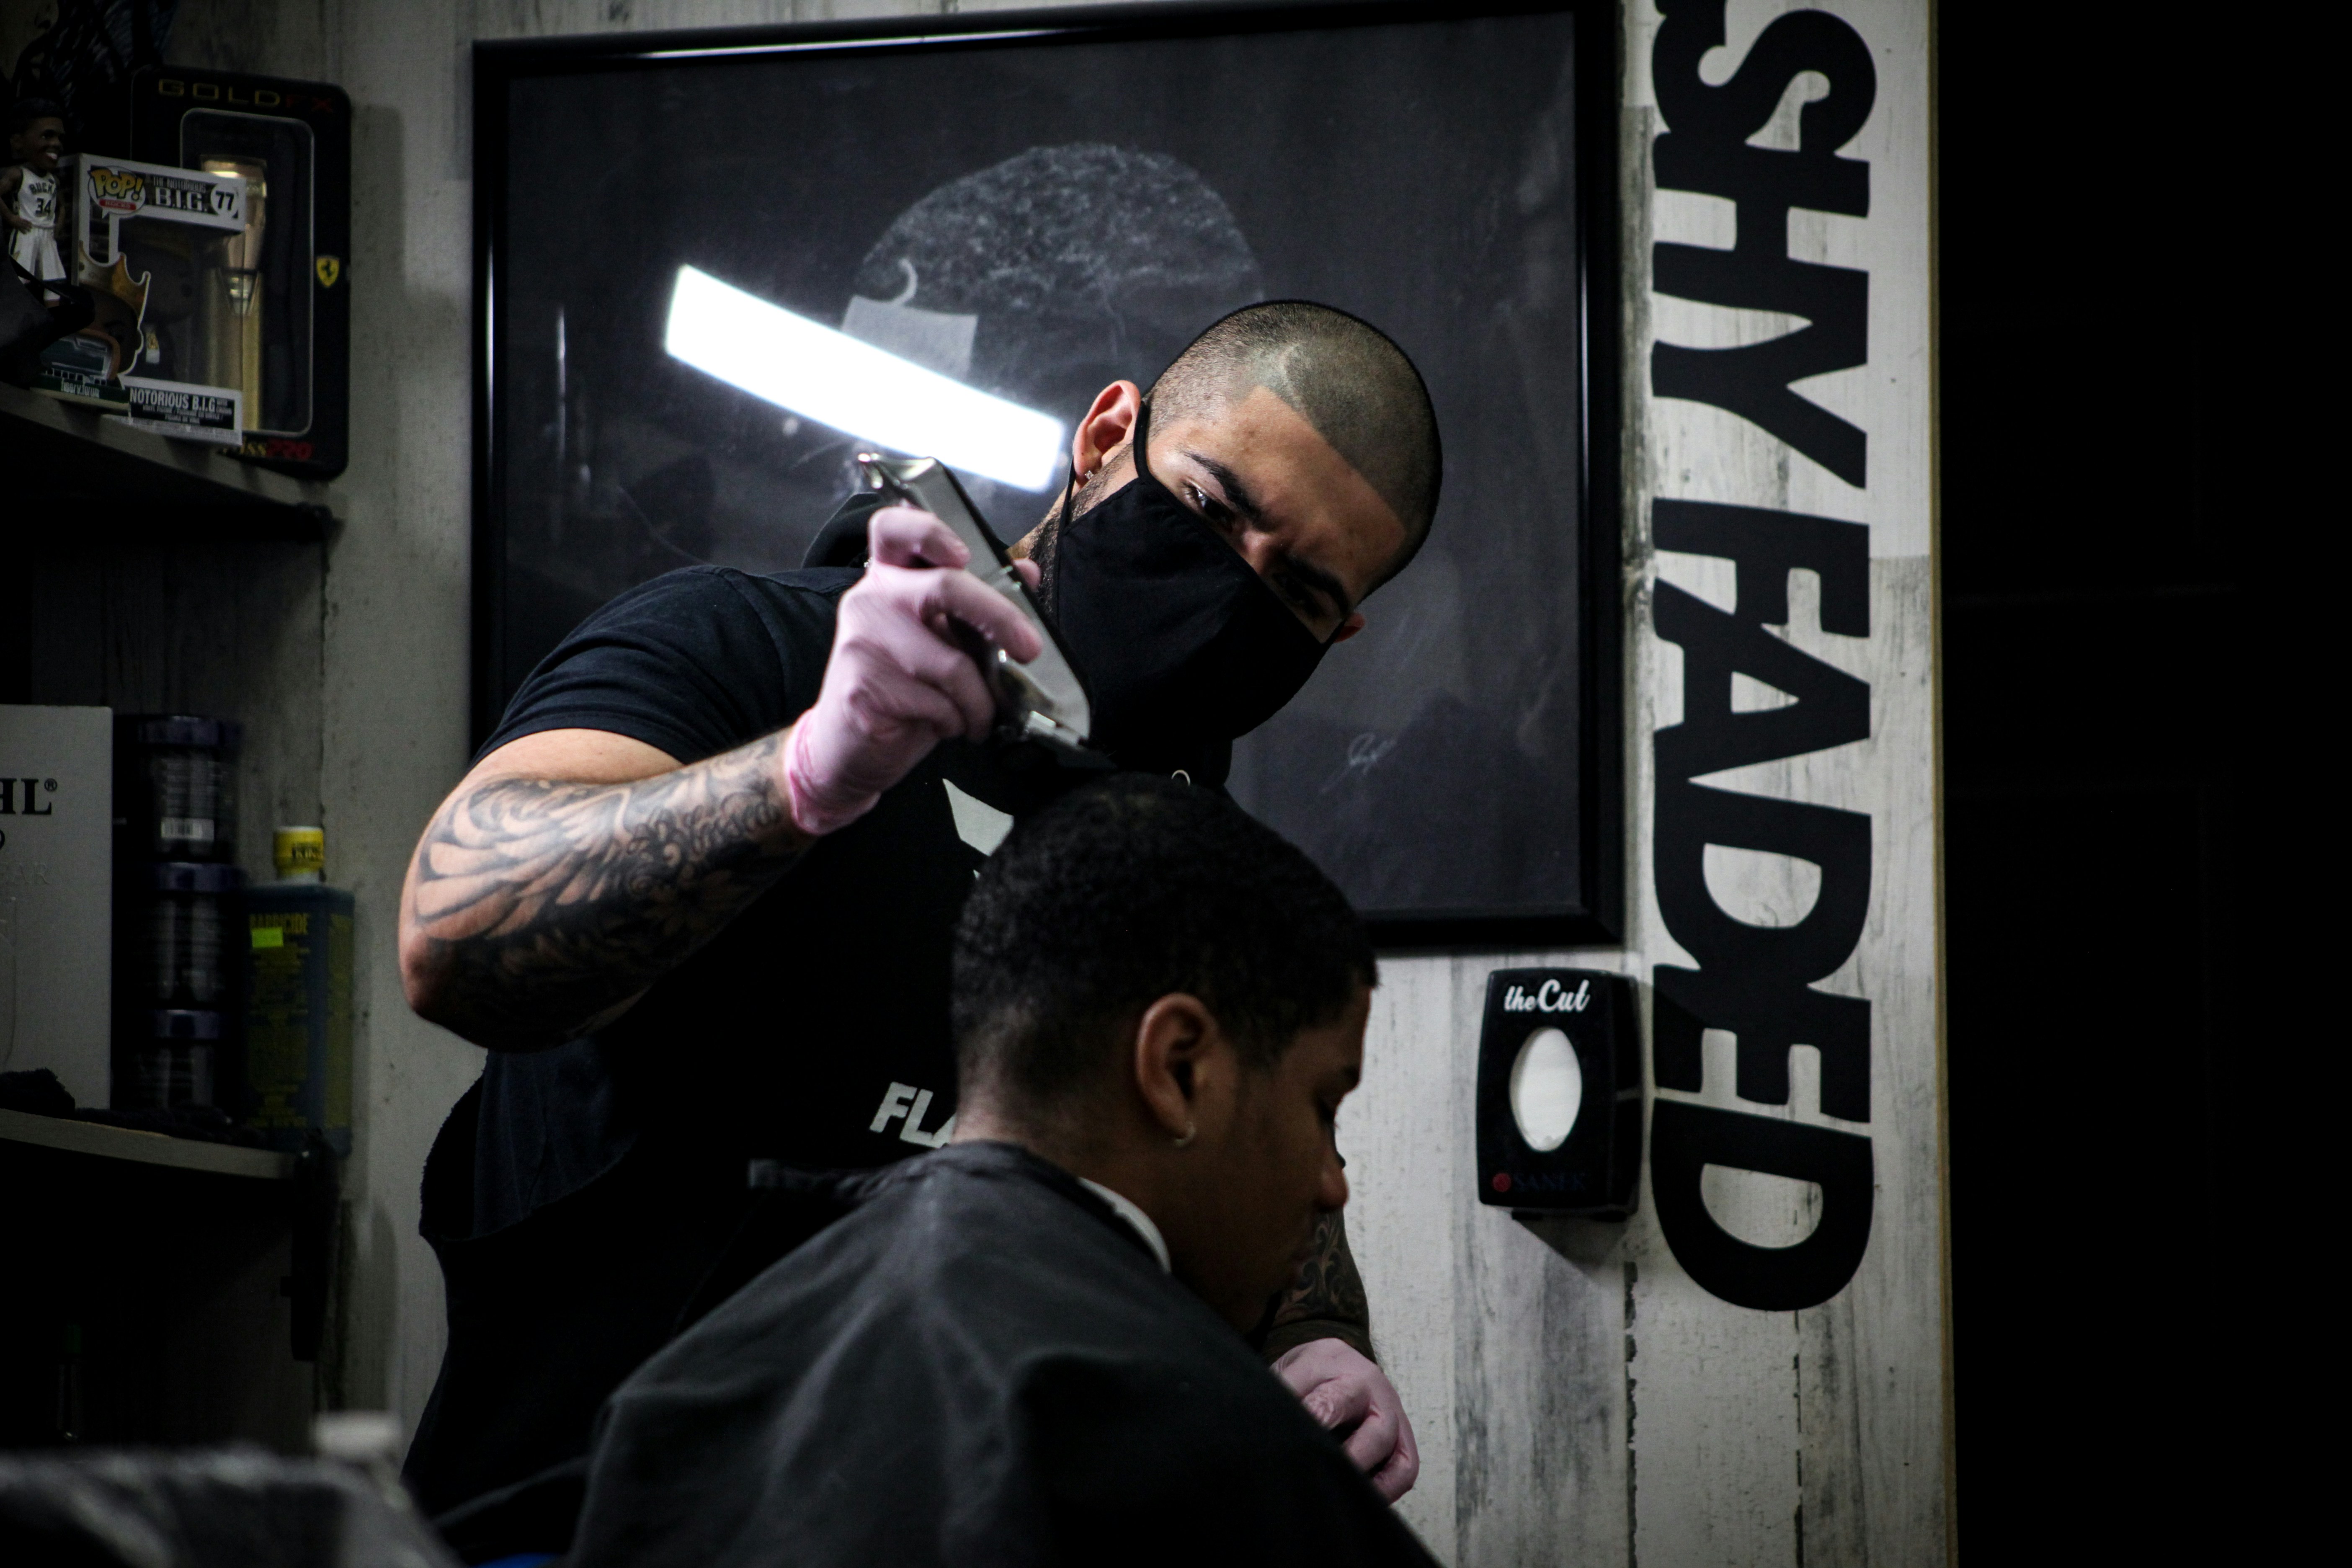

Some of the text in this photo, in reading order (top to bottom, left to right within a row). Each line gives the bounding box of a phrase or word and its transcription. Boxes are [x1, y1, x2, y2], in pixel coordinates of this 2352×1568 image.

[158, 78, 334, 113] GOLDFX
[90, 168, 144, 201] POP!
[216, 191, 234, 210] 77
[35, 197, 52, 216] 34
[129, 387, 189, 410] NOTORIOUS
[191, 395, 215, 413] B.I.G
[1651, 0, 1876, 1311] SHY FADED
[1504, 978, 1591, 1014] theCut
